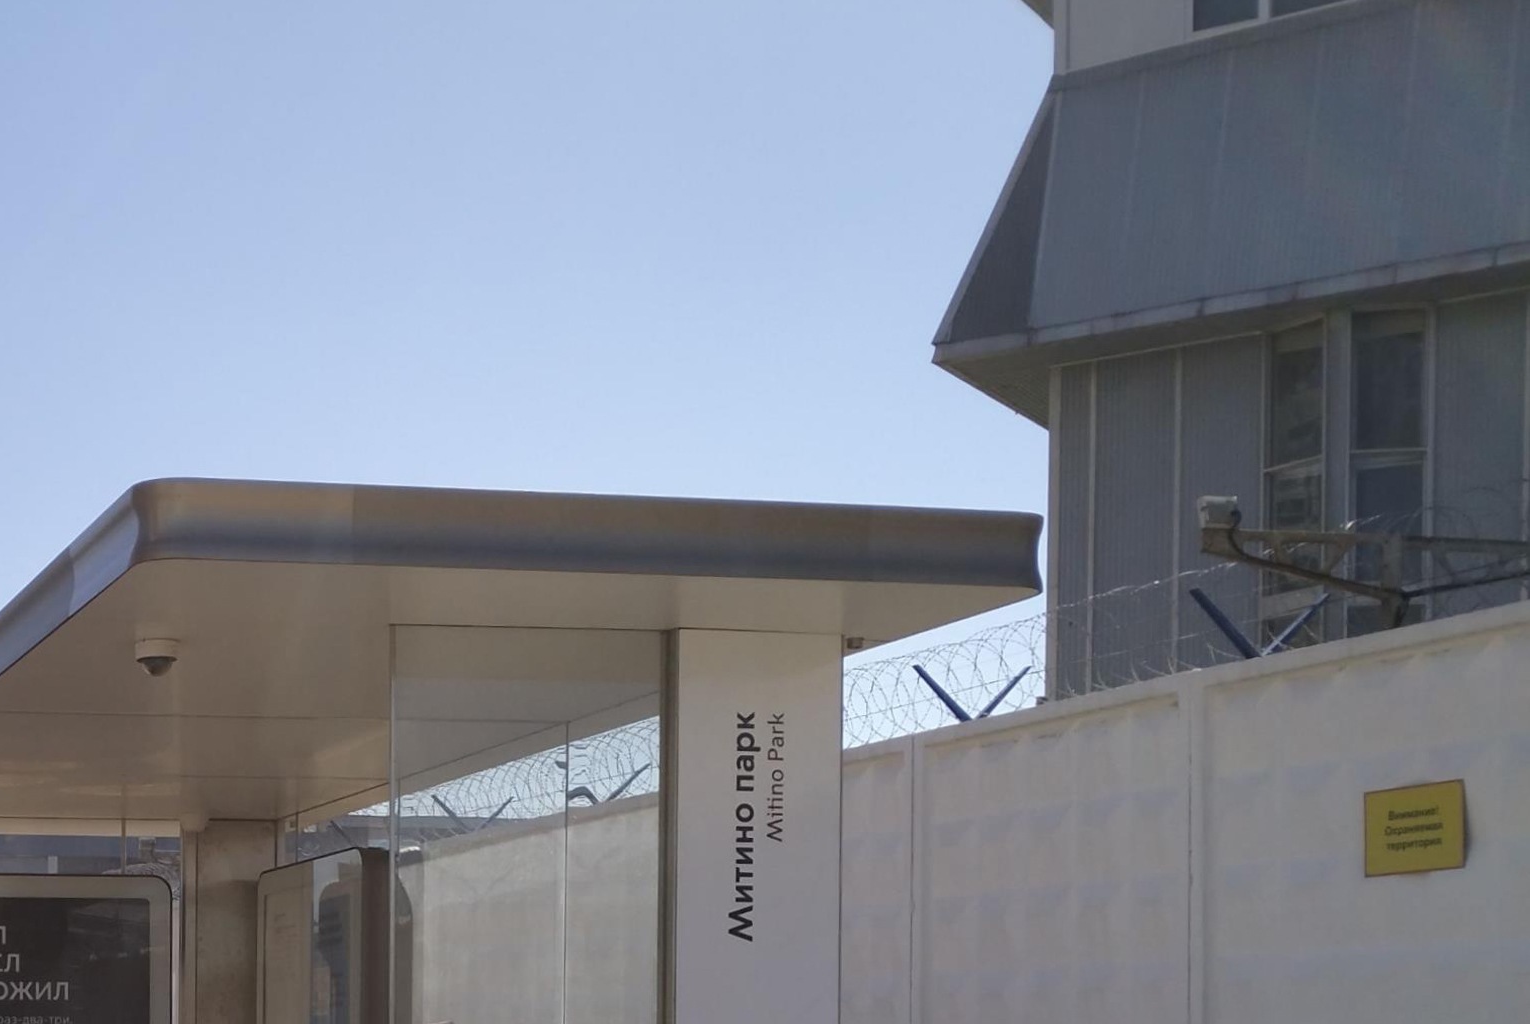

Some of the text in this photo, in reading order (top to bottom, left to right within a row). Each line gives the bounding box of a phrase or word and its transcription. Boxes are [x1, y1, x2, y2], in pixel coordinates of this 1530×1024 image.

[728, 711, 761, 942] Митино парк
[766, 712, 786, 843] Mitino Park
